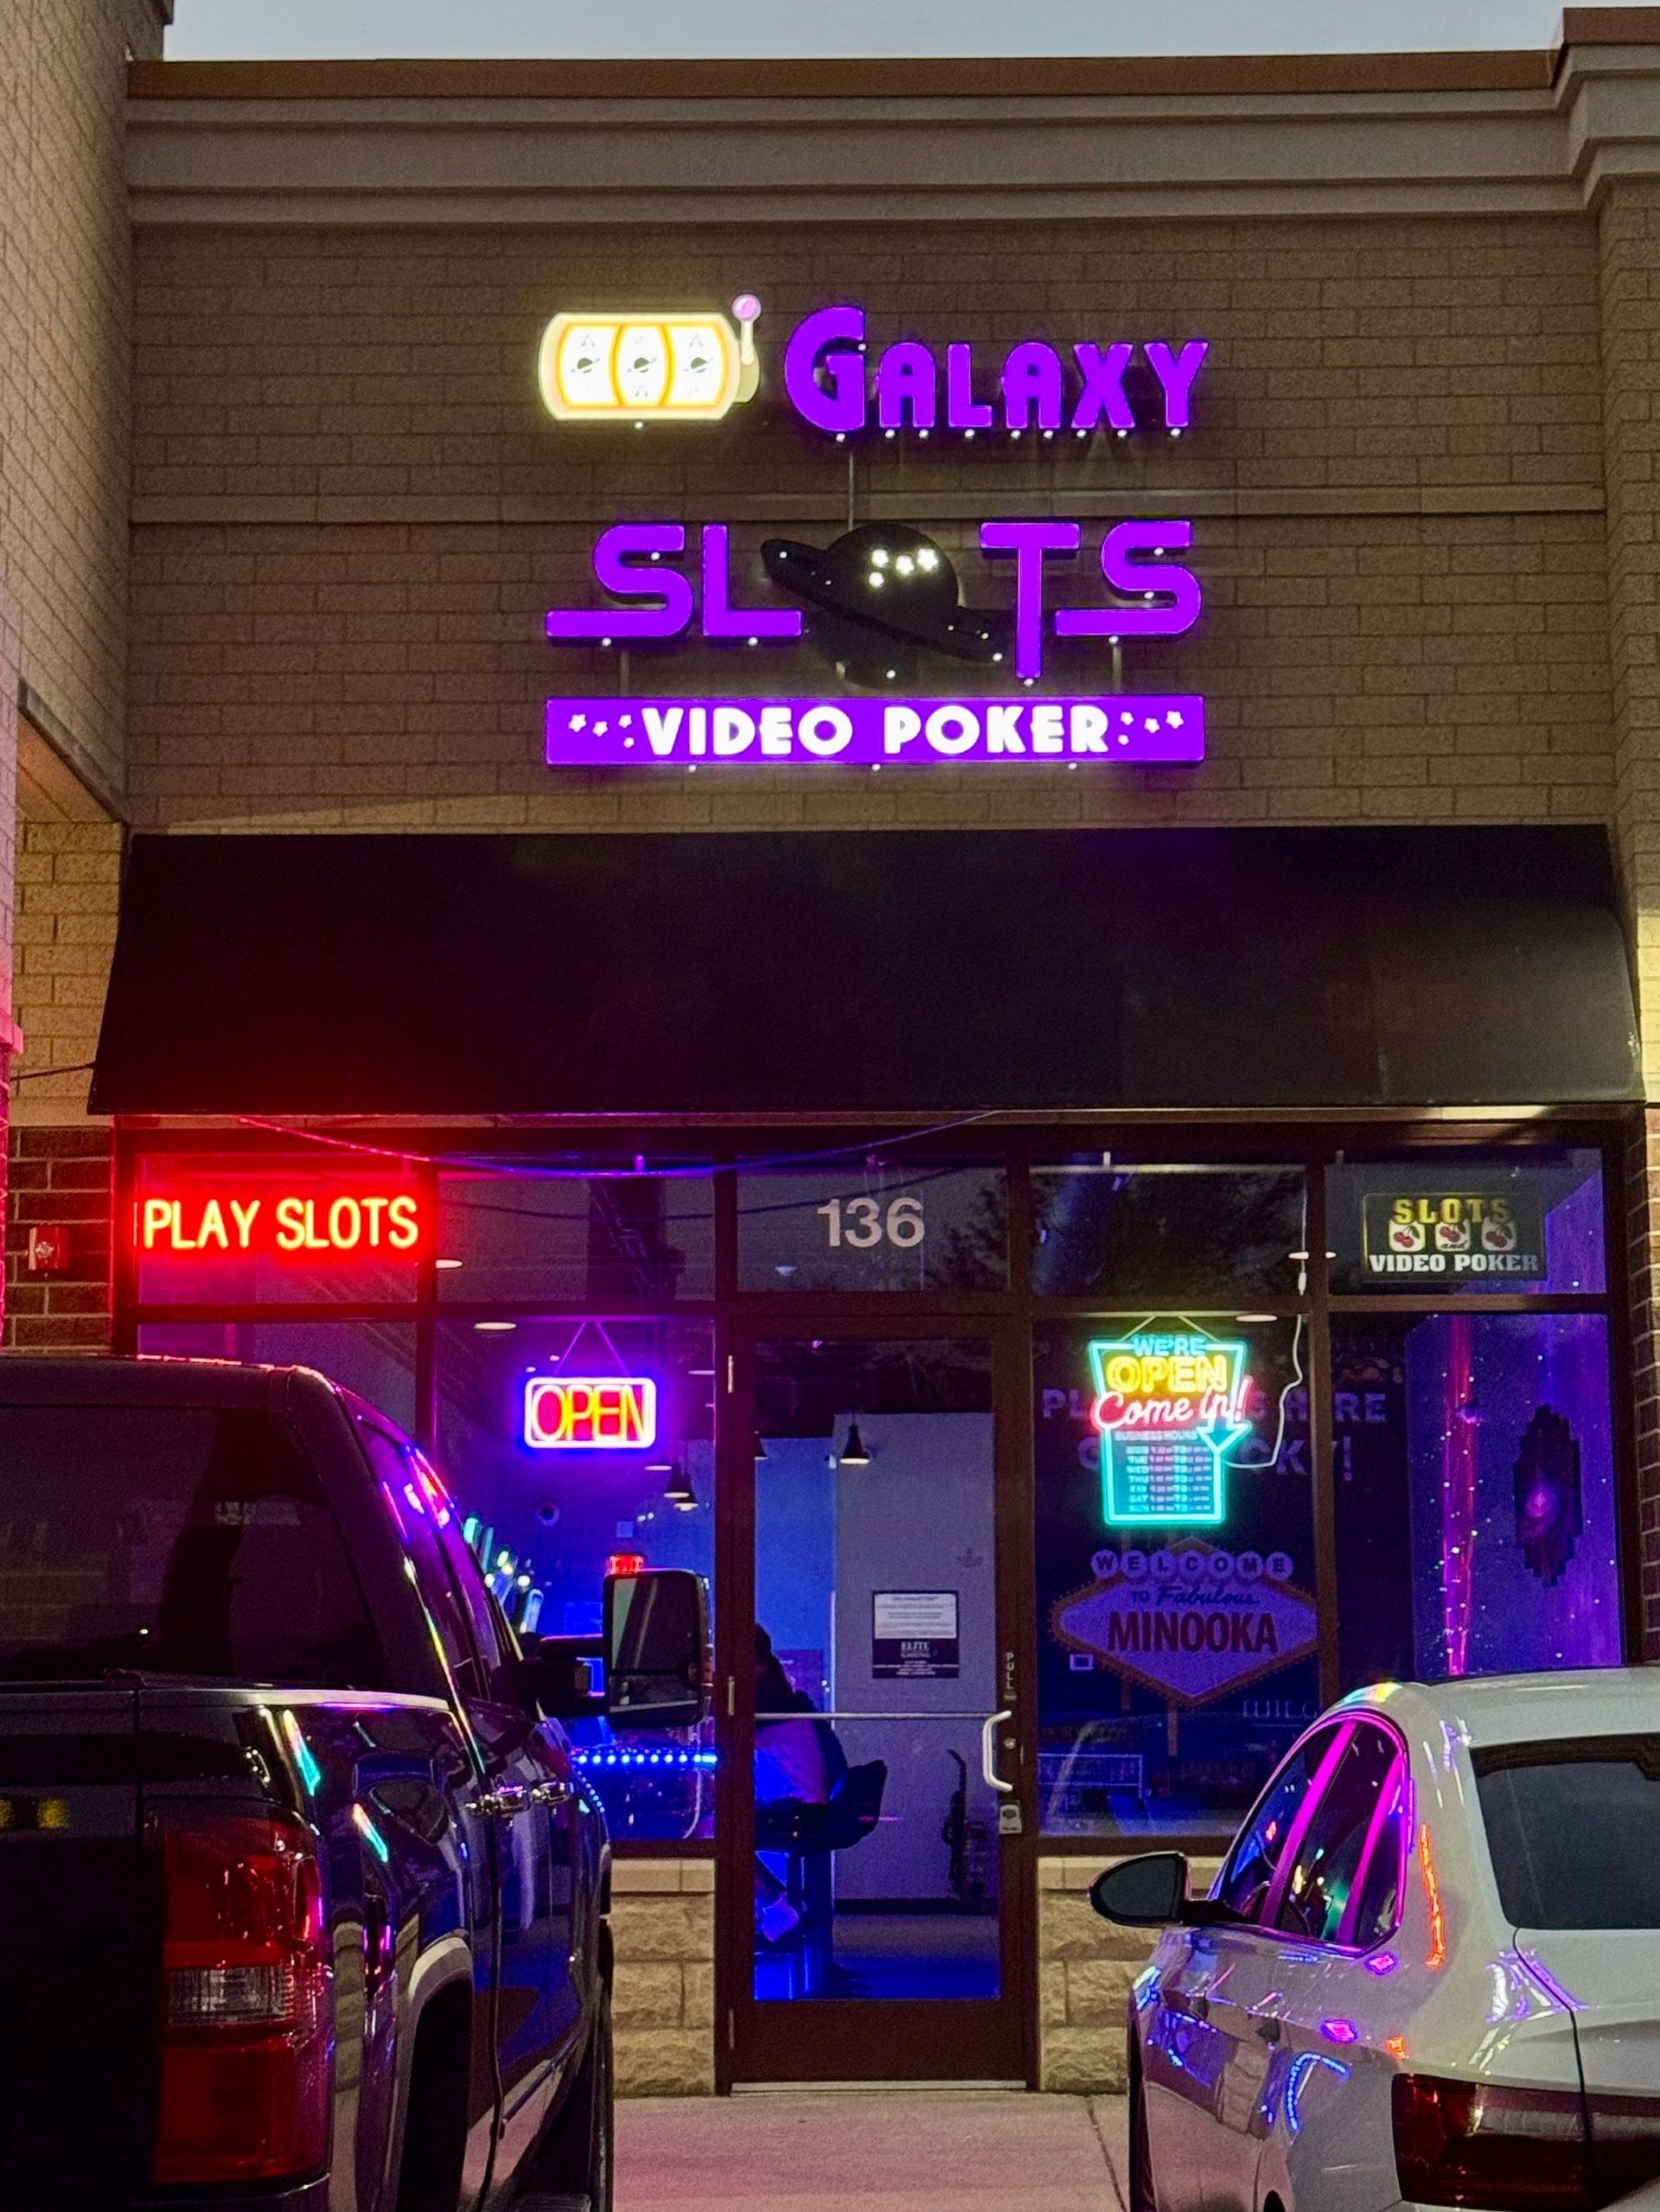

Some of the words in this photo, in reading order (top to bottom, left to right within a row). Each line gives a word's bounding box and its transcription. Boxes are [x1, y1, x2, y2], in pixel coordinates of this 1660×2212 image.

[642, 707, 853, 756] VIDEO
[883, 704, 1110, 754] POKER
[144, 1198, 260, 1250] PLAY
[276, 1196, 419, 1251] SLOTS
[817, 1197, 924, 1248] 136
[1394, 1198, 1510, 1224] SLOTS
[1369, 1254, 1446, 1272] VIDEO
[1454, 1253, 1540, 1272] POKER
[1133, 1335, 1207, 1357] WE'RE
[1106, 1355, 1228, 1394] OPEN
[530, 1383, 651, 1444] OPEN
[1095, 1391, 1194, 1429] Come
[1095, 1555, 1286, 1573] WELCOME
[1132, 1590, 1151, 1603] TO
[1156, 1585, 1260, 1605] Fabulous
[1108, 1611, 1279, 1653] MINOOKA
[1006, 1652, 1016, 1690] PULL
